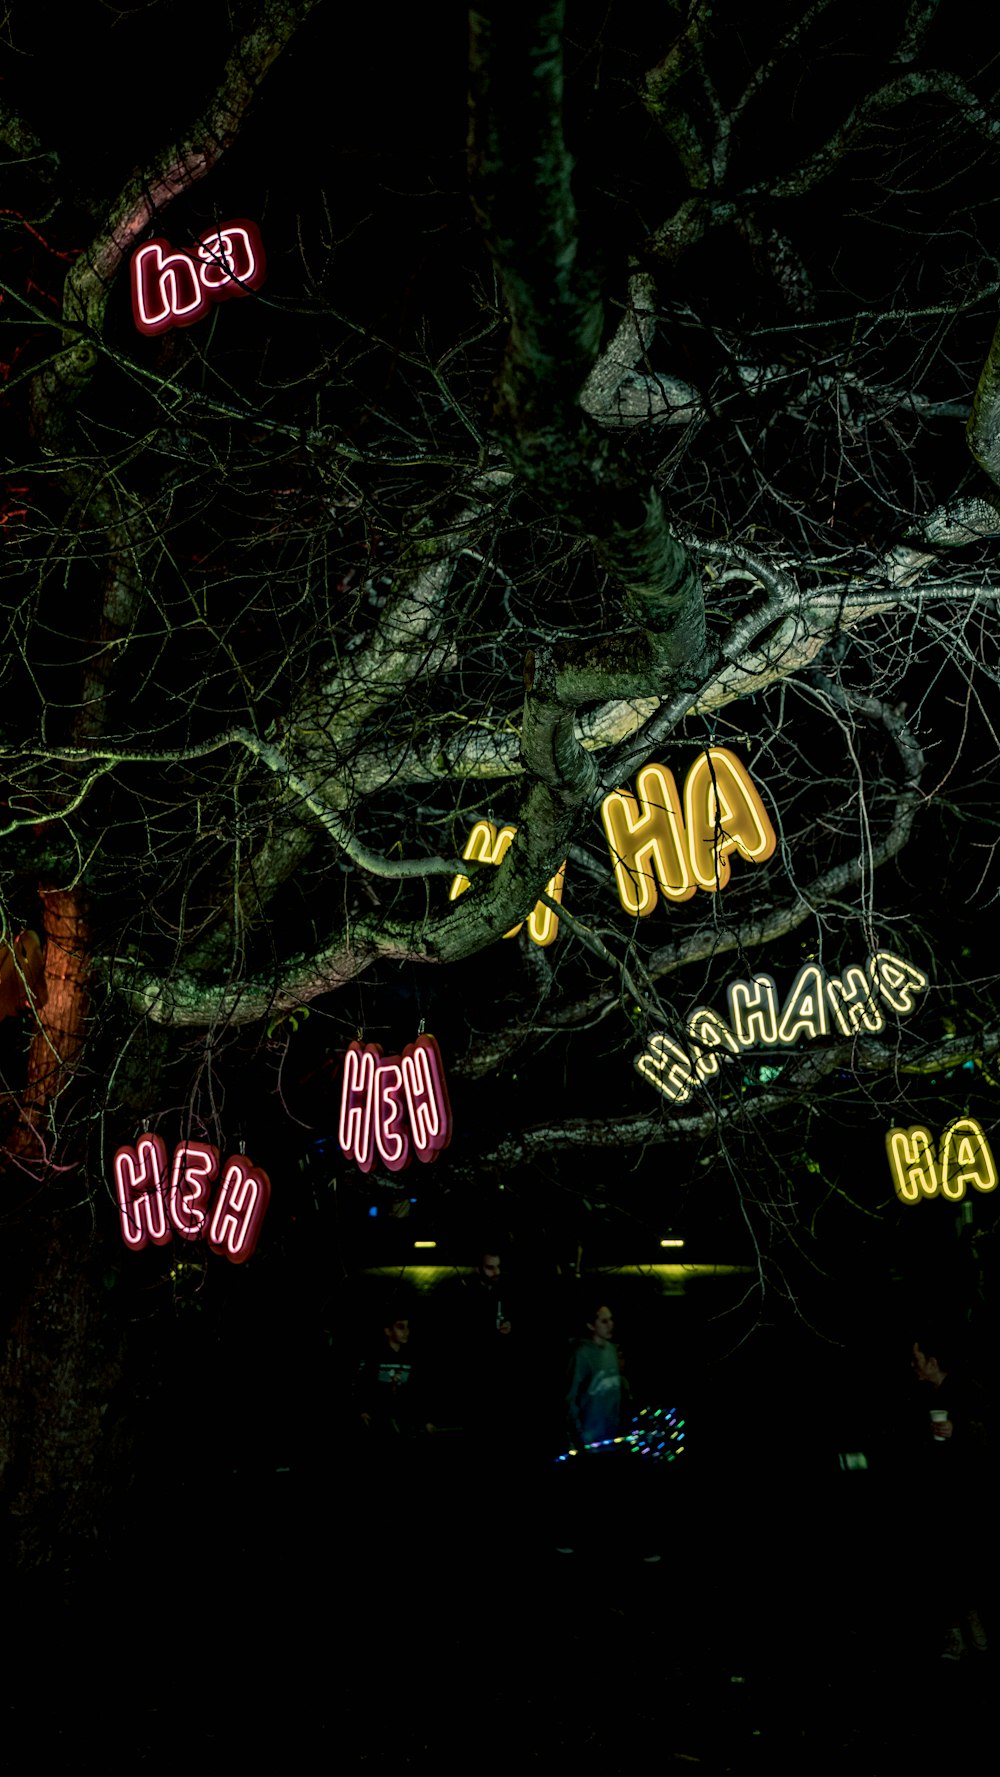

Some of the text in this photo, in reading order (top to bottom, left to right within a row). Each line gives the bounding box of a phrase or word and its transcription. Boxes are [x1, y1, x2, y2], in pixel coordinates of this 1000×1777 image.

[133, 224, 259, 328] ha
[601, 749, 772, 915] HA
[637, 953, 926, 1101] HAHAHA
[338, 1041, 444, 1167] HEH
[889, 1118, 996, 1202] HA
[114, 1137, 263, 1258] HEH
